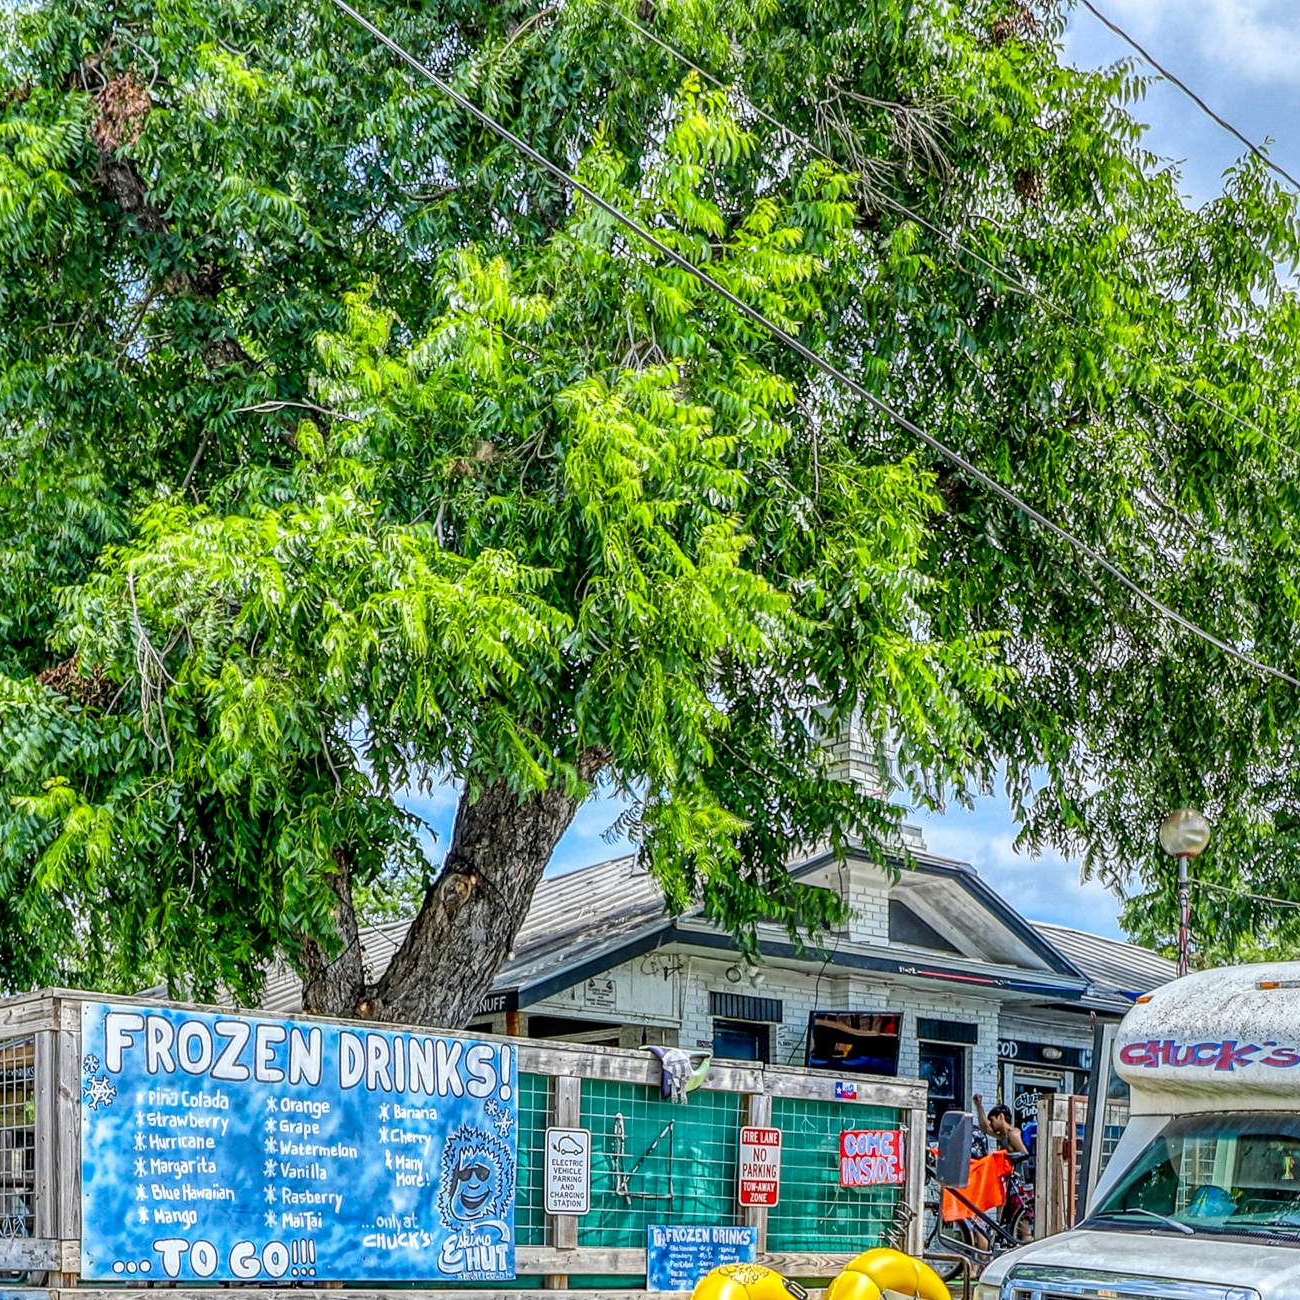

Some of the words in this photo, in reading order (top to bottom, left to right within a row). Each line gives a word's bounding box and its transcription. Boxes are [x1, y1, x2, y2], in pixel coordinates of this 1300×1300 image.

[104, 1012, 322, 1087] FROZEN
[338, 1030, 512, 1101] DRINKS!
[182, 1089, 229, 1110] Colada
[280, 1098, 330, 1119] Orange
[394, 1103, 438, 1120] Banana
[147, 1111, 229, 1136] Strawberry
[280, 1119, 320, 1140] Grape
[149, 1132, 216, 1150] Hurricane
[391, 1129, 432, 1157] Cherry
[743, 1131, 759, 1143] FIRE
[760, 1131, 778, 1144] LANE
[843, 1132, 894, 1157] COME
[280, 1140, 358, 1159] Watermelon
[752, 1147, 767, 1162] NO
[150, 1156, 217, 1180] Margarita
[280, 1162, 327, 1180] Vanilla
[395, 1155, 423, 1176] Many
[551, 1158, 584, 1167] ELECTRIC
[553, 1167, 582, 1175] VEHICLE
[742, 1163, 777, 1178] PARKING
[396, 1173, 431, 1187] More!
[552, 1175, 583, 1183] PARKING
[742, 1181, 776, 1193] TOW-AWAY
[151, 1183, 181, 1201] Blue
[281, 1186, 343, 1214] Rasberry
[549, 1191, 585, 1200] CHARGING
[749, 1193, 768, 1203] ZONE
[553, 1200, 582, 1208] STATION
[153, 1208, 198, 1230] Mango
[403, 1212, 419, 1229] at
[666, 1228, 710, 1243] FROZEN
[712, 1228, 752, 1246] DRINKS
[465, 1245, 509, 1273] HUT
